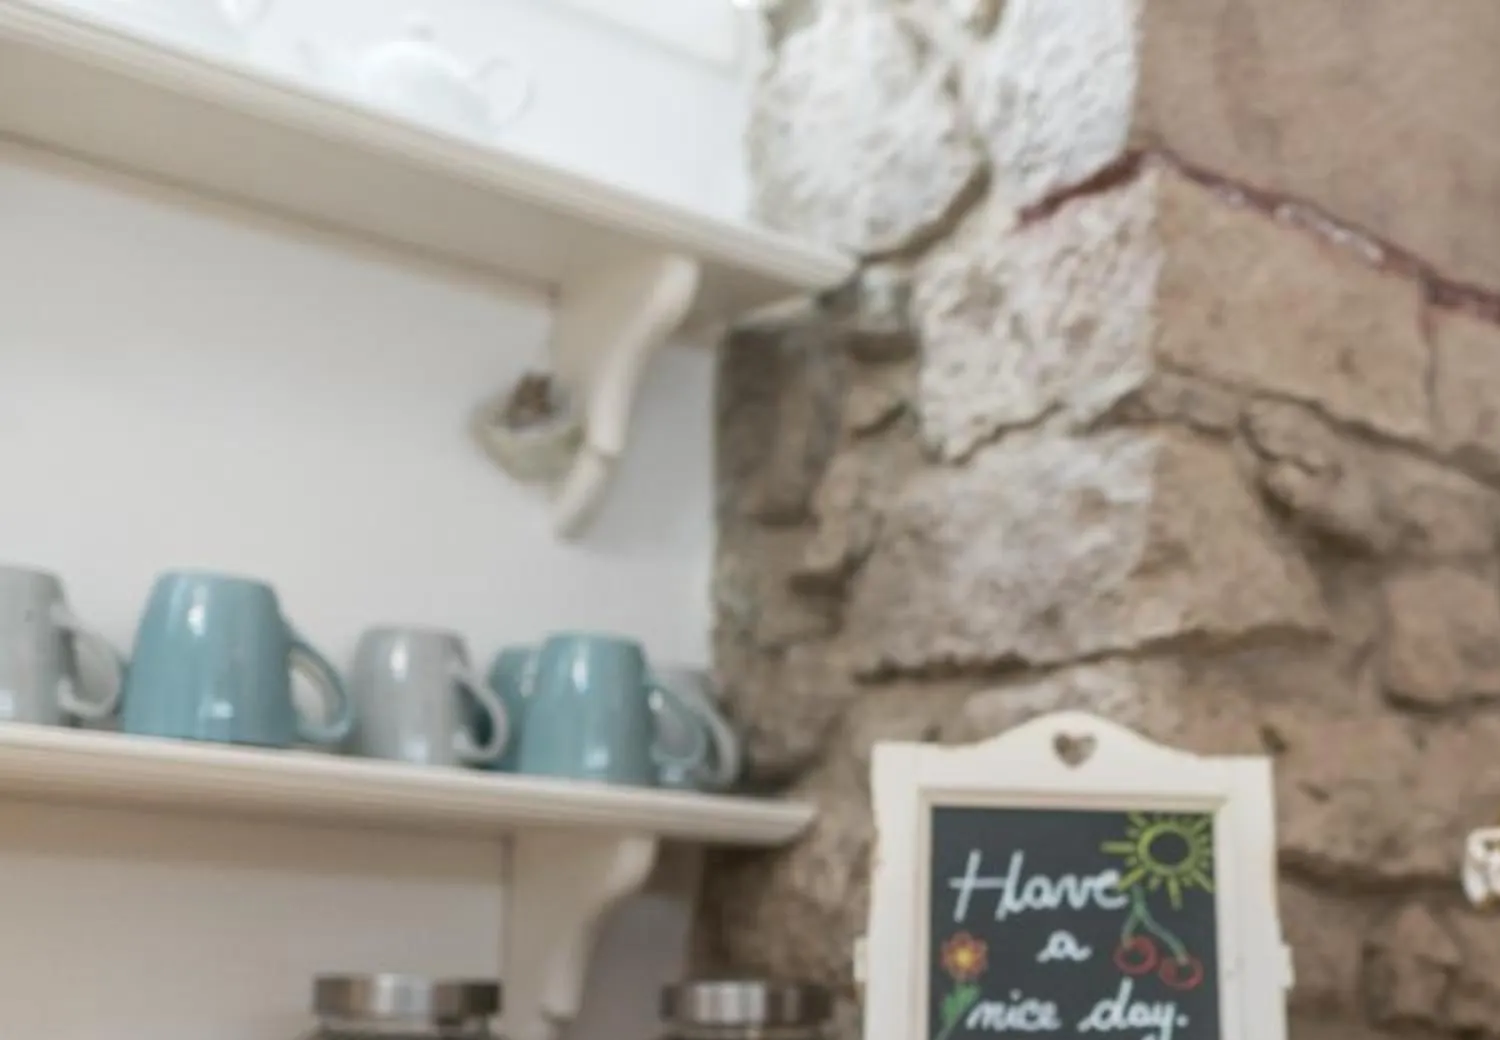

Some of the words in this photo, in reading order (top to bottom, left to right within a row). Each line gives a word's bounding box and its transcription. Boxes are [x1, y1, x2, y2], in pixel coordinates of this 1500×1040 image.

[949, 848, 1128, 922] Have
[1036, 930, 1092, 963] a
[965, 989, 1061, 1032] nice
